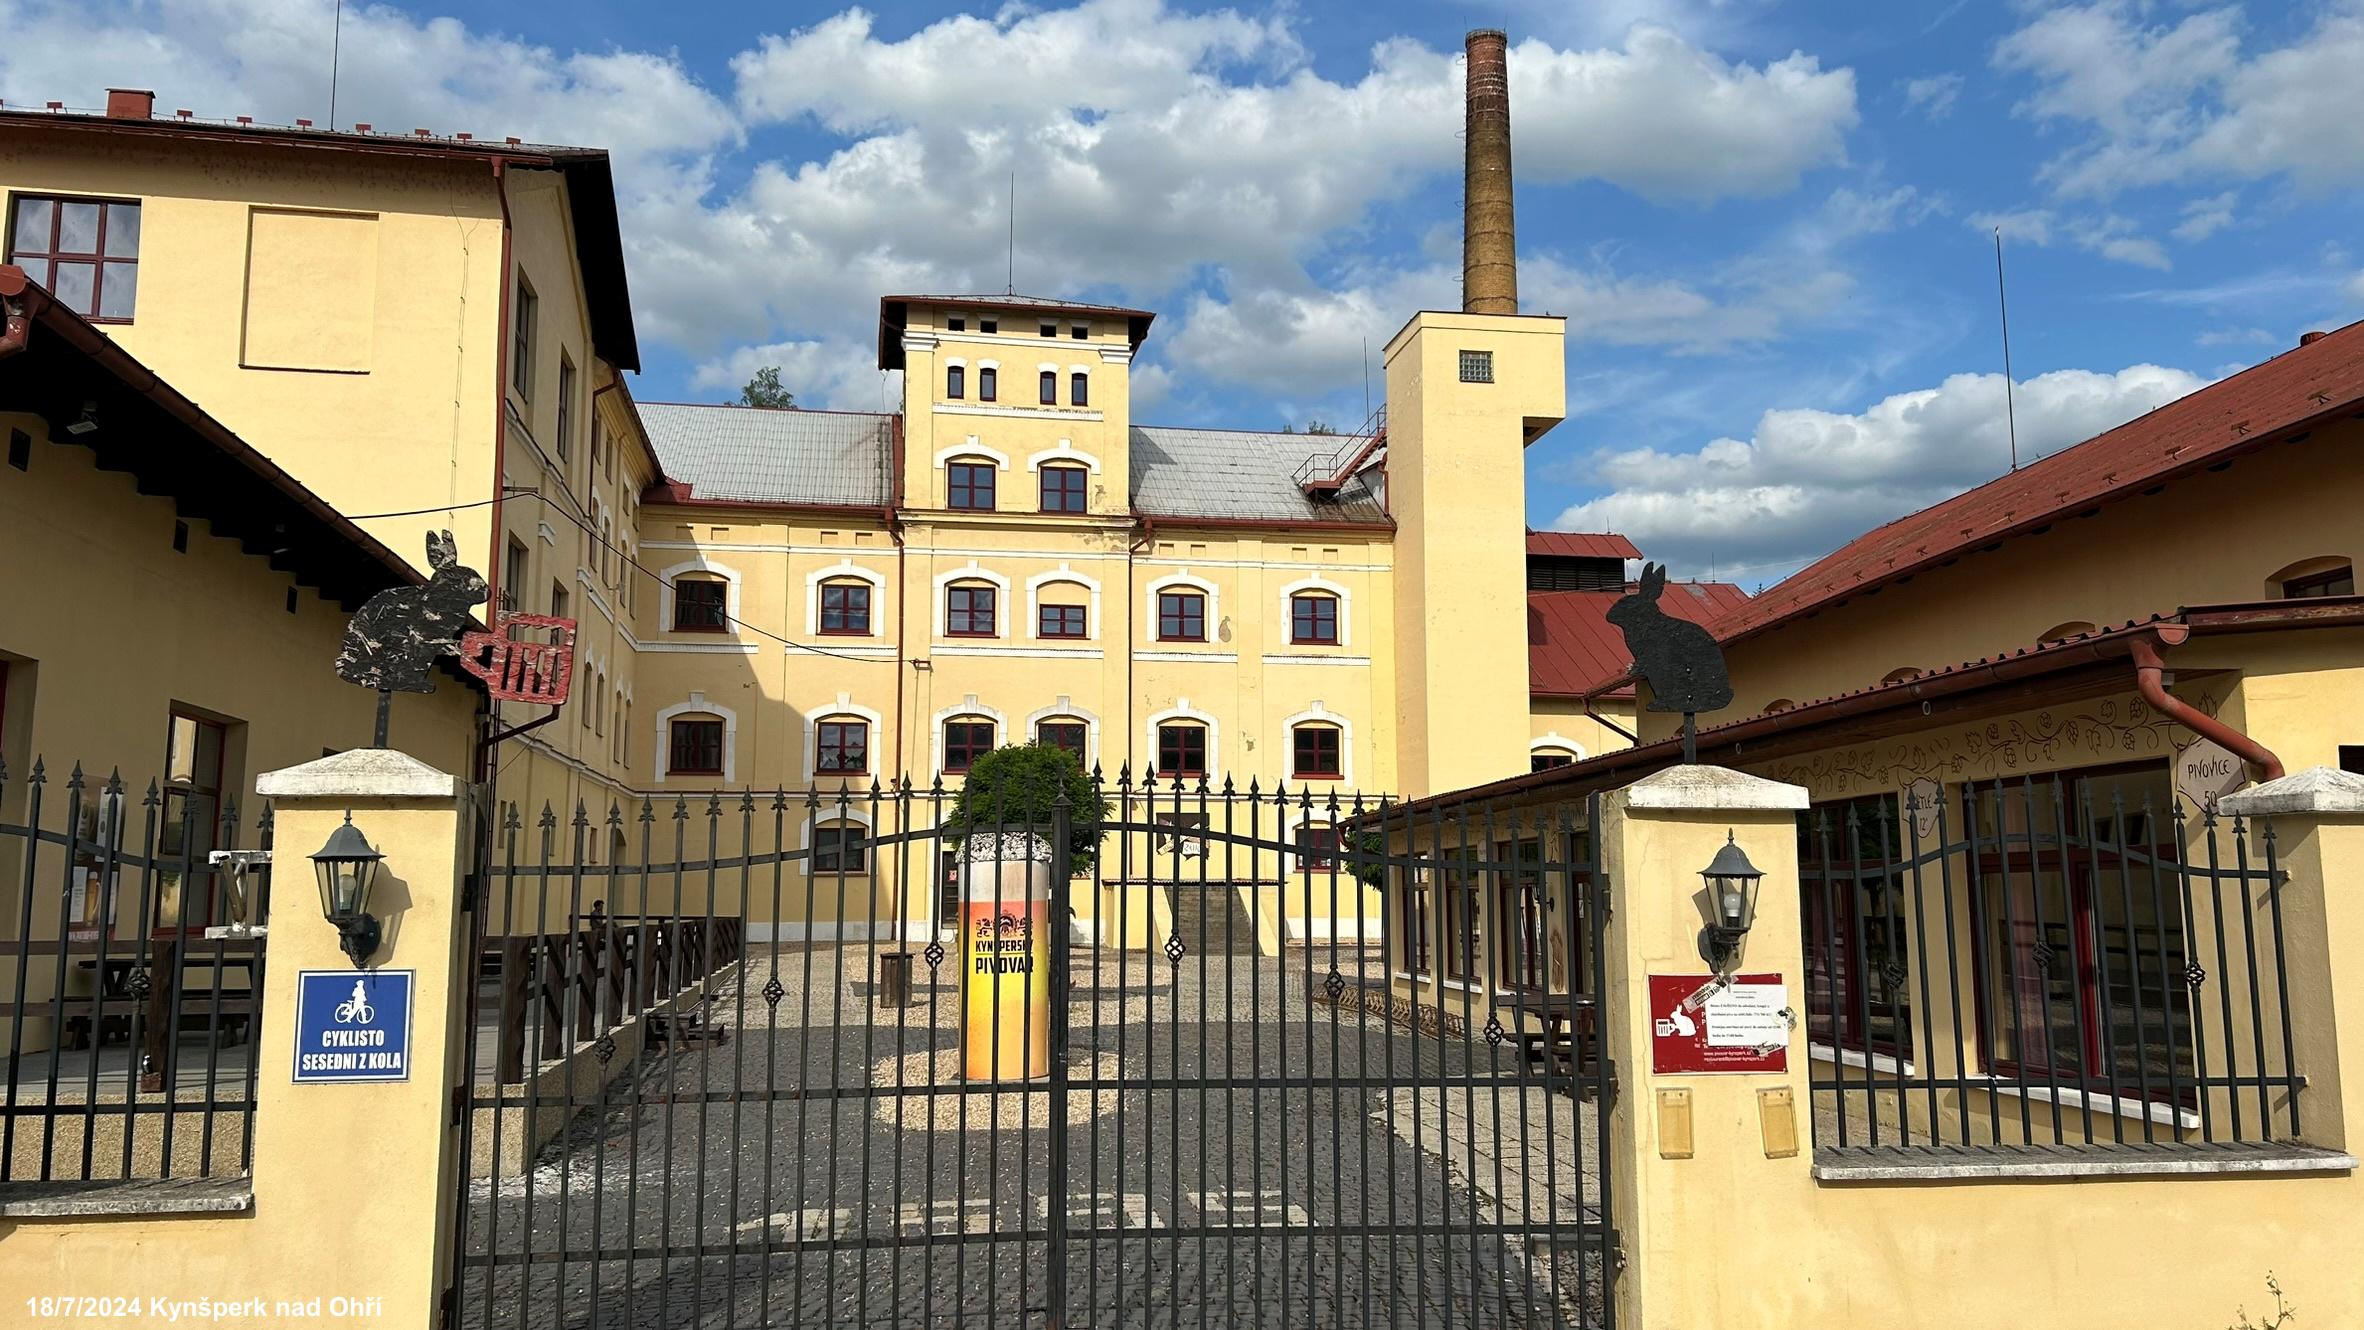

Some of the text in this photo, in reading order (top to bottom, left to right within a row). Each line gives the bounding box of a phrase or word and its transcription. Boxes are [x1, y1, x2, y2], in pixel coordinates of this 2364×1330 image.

[2187, 754, 2231, 780] PIVOVICE
[975, 939, 1034, 953] KYNPERS
[322, 1029, 385, 1048] CYKLISTO
[302, 1052, 402, 1071] SESEDNI Z KOLA
